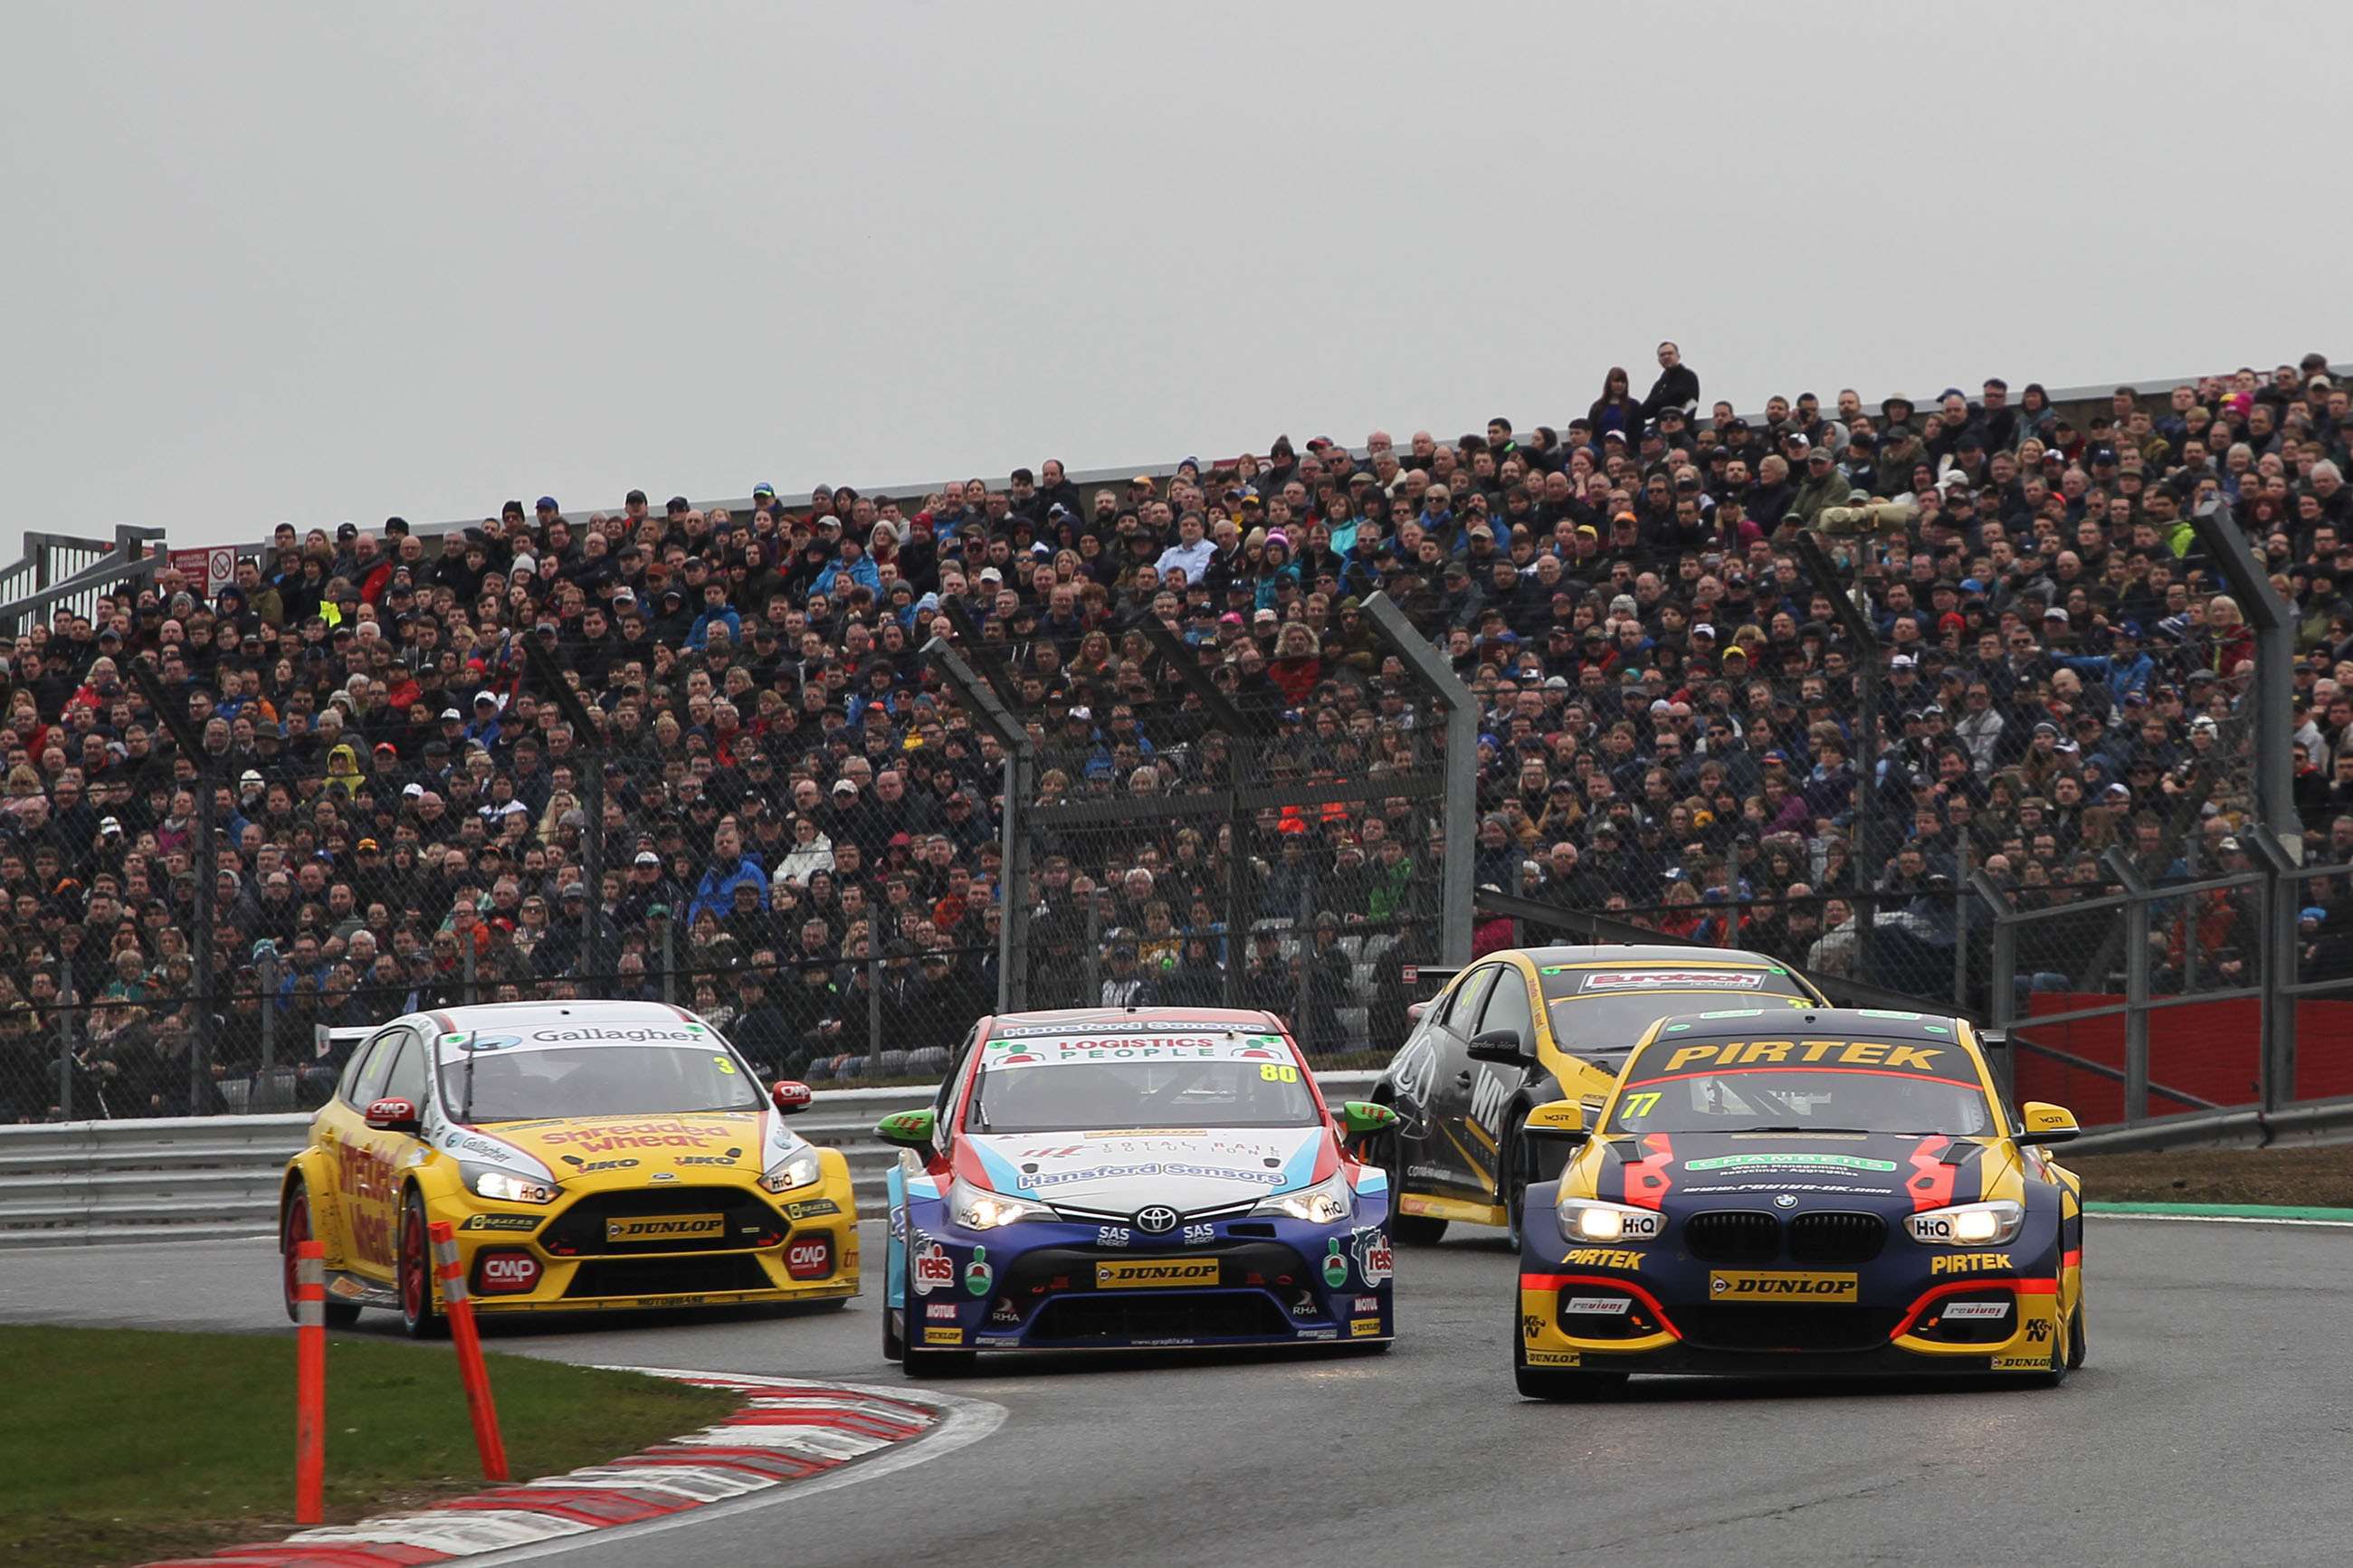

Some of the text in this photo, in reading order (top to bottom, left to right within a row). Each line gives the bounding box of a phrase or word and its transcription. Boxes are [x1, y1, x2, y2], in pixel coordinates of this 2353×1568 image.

[1591, 974, 1754, 984] Eurotech
[530, 1028, 702, 1042] Gallagher
[1003, 1022, 1266, 1037] Hansford Sensors
[1059, 1038, 1214, 1050] LOGISTICS
[1061, 1048, 1215, 1060] PEOPLE
[1664, 1041, 1945, 1071] PIRTEK
[712, 1056, 736, 1075] 3
[1260, 1063, 1298, 1083] 80
[1621, 1092, 1662, 1119] 77
[462, 1136, 511, 1163] Gallagher
[1698, 1154, 1884, 1168] CHAMBERS
[771, 1174, 793, 1189] HiQ
[1019, 1164, 1285, 1188] Hansford Sensors
[520, 1184, 546, 1201] HiQ
[1320, 1201, 1343, 1217] HiQ
[626, 1220, 723, 1235] DUNLOP
[1183, 1223, 1215, 1239] SAS
[1623, 1217, 1654, 1233] HiQ
[1916, 1220, 1949, 1237] HiQ
[1098, 1226, 1130, 1240] SAS
[1184, 1235, 1216, 1245] ENERGY
[1096, 1238, 1129, 1247] ENERGY
[1369, 1236, 1392, 1270] reis
[1560, 1249, 1647, 1270] PIRTEK
[919, 1245, 953, 1279] reis
[1931, 1253, 2014, 1275] PIRTEK
[1116, 1265, 1217, 1279] DUNLOP
[1734, 1278, 1856, 1294] DUNLOP
[926, 1304, 957, 1318] MOTUL
[992, 1312, 1021, 1322] RHA
[1292, 1306, 1318, 1315] RHA
[1529, 1354, 1579, 1364] DUNLOP
